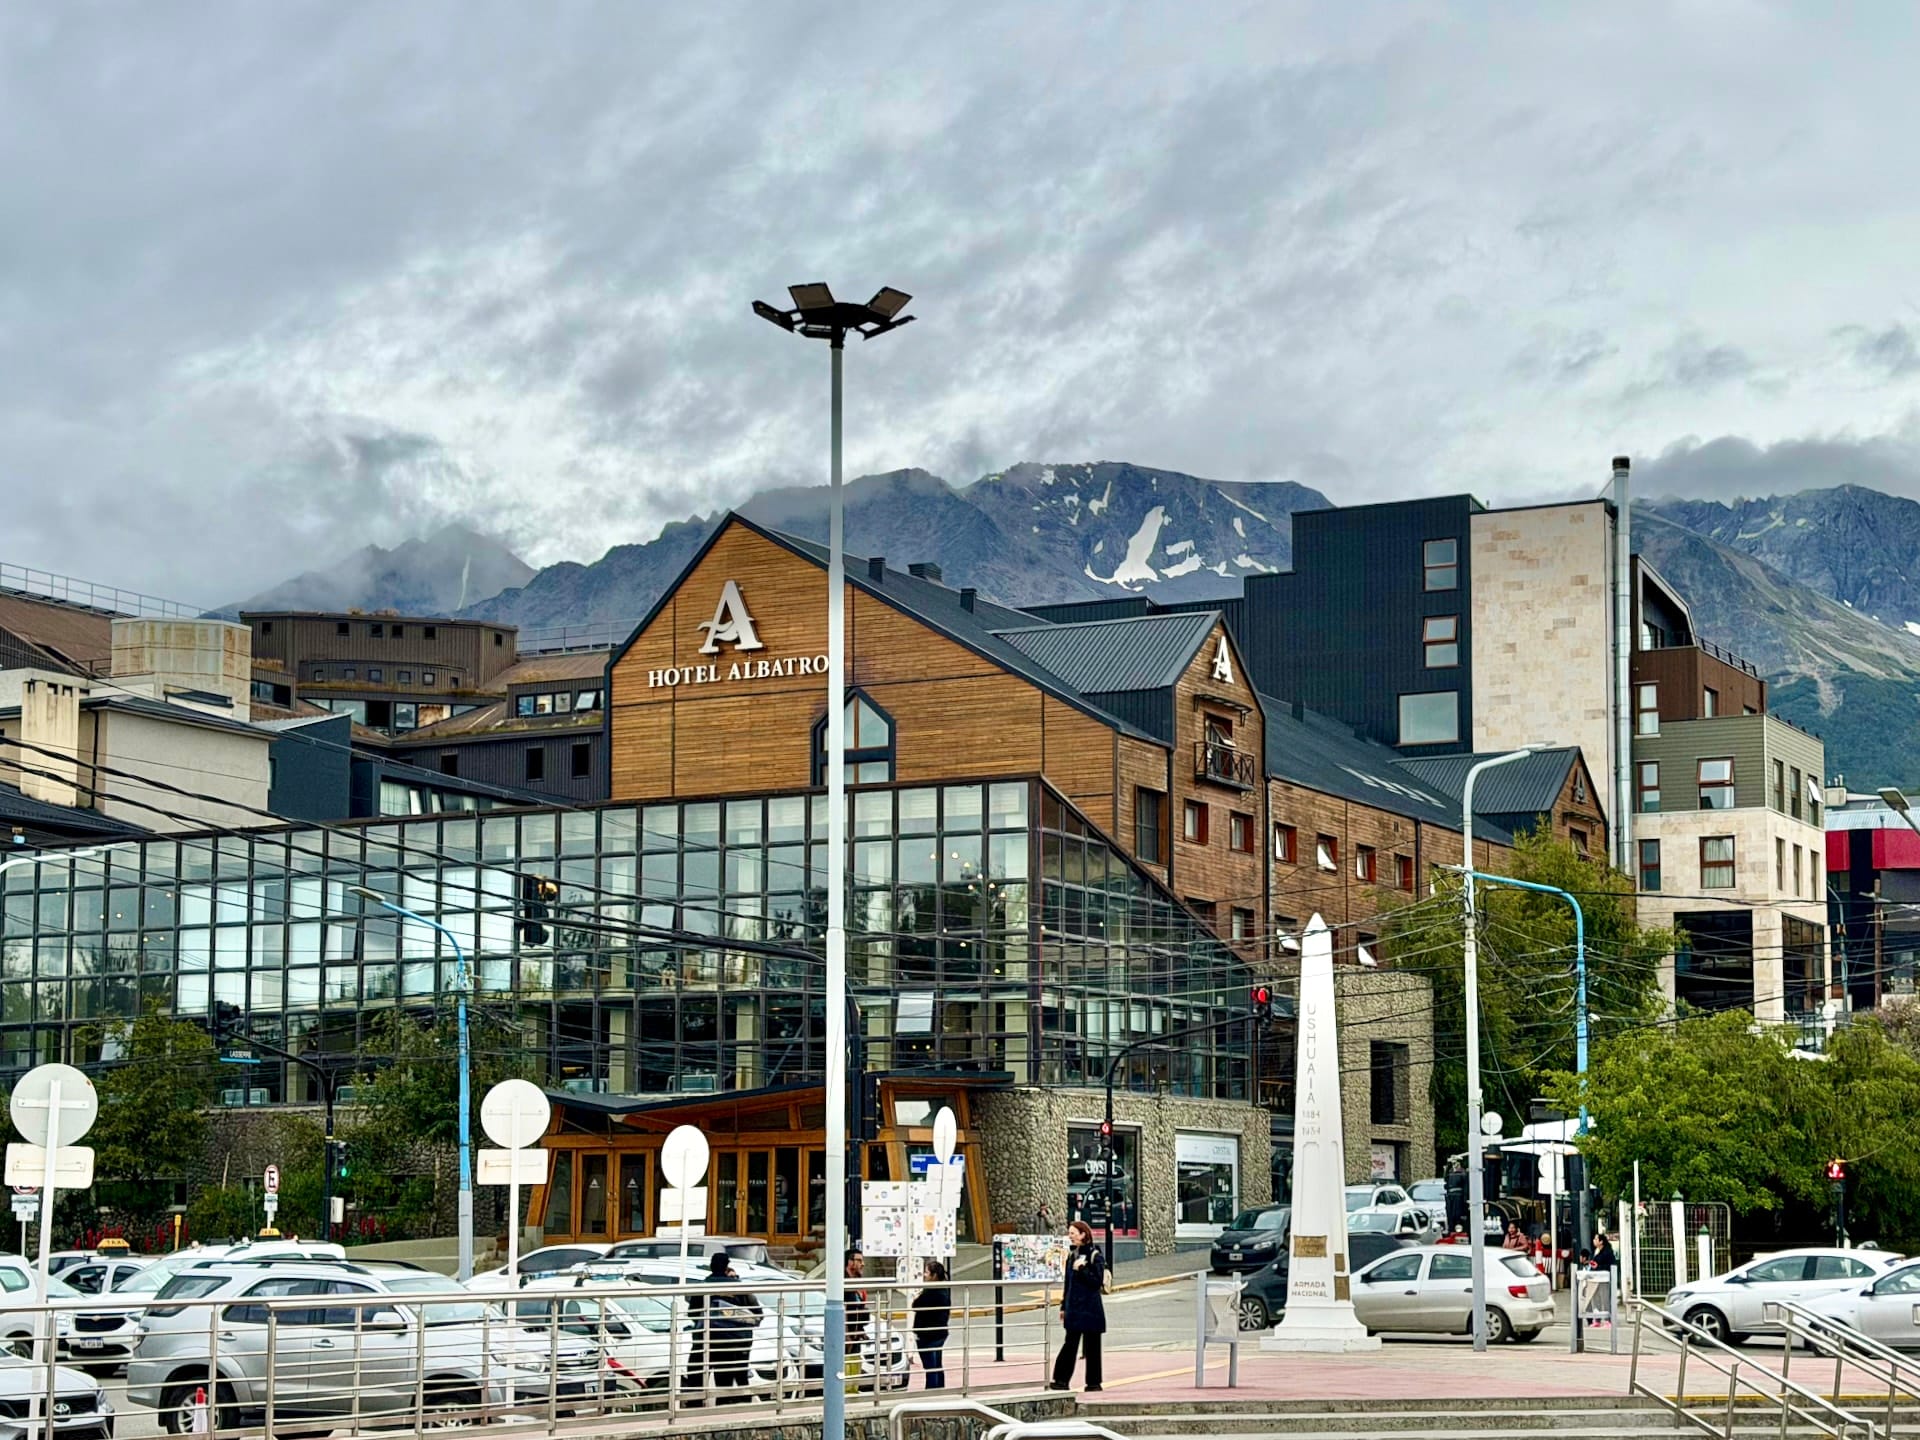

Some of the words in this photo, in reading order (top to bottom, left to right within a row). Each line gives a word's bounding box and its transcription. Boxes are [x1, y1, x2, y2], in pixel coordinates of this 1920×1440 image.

[648, 664, 721, 688] HOTEL
[727, 655, 830, 682] ALBATRO
[1306, 1003, 1317, 1104] USHUAIA
[1085, 1160, 1117, 1175] CRYSTL
[1291, 1290, 1329, 1298] NACIONAL
